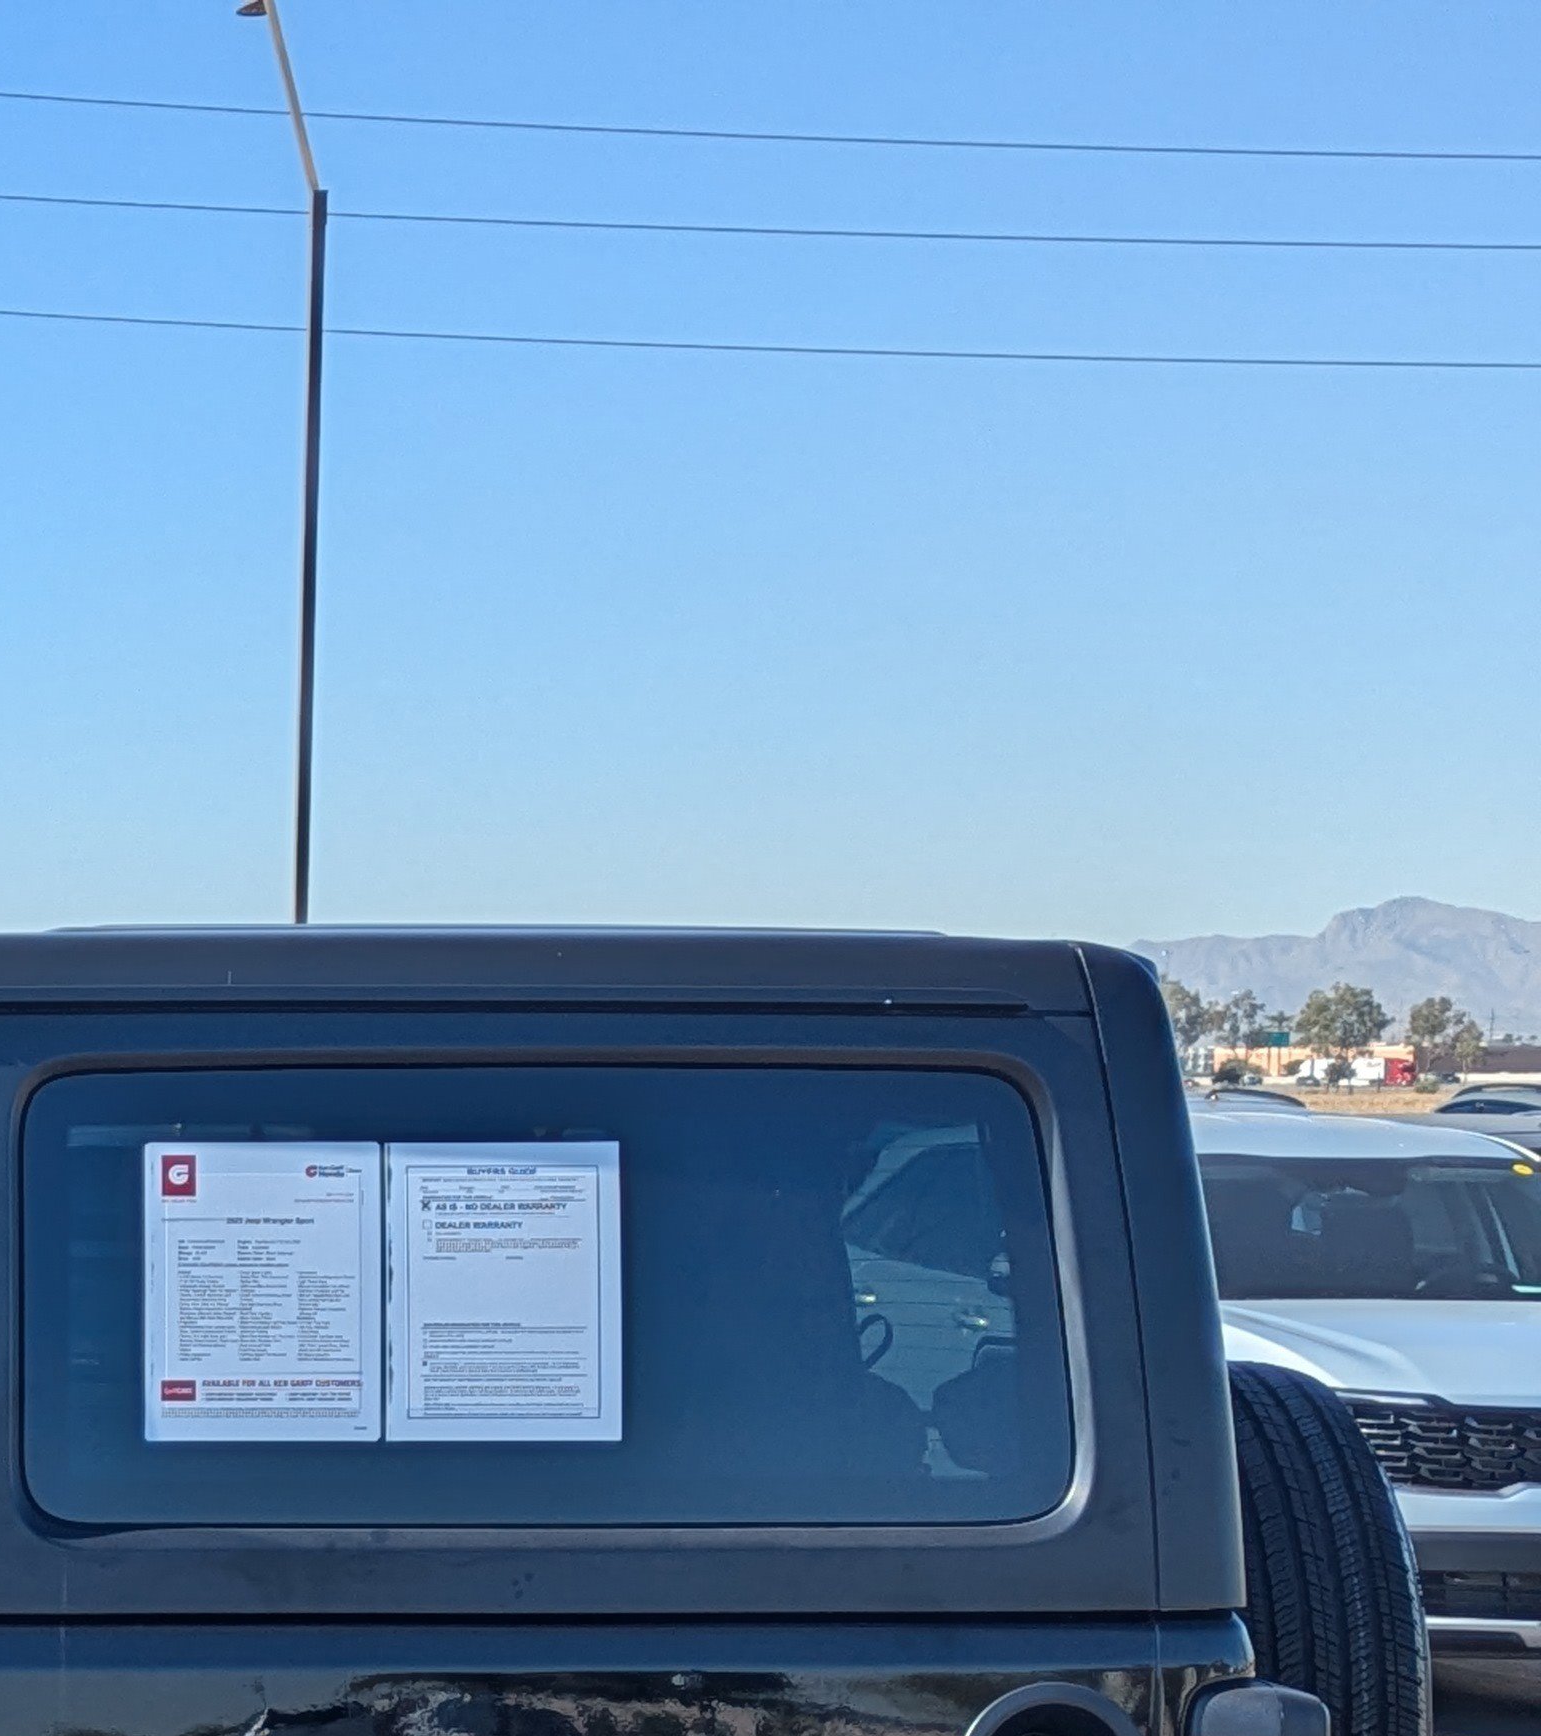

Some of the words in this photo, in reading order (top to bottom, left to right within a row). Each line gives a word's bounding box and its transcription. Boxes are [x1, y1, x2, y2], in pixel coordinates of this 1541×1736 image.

[435, 1203, 447, 1211] AS
[480, 1203, 516, 1211] DEALER
[517, 1202, 568, 1211] WARRANTY
[263, 1217, 293, 1226] Wrangler
[435, 1221, 471, 1230] DEALER
[473, 1221, 523, 1230] WARRANTY
[258, 1379, 271, 1387] ALL
